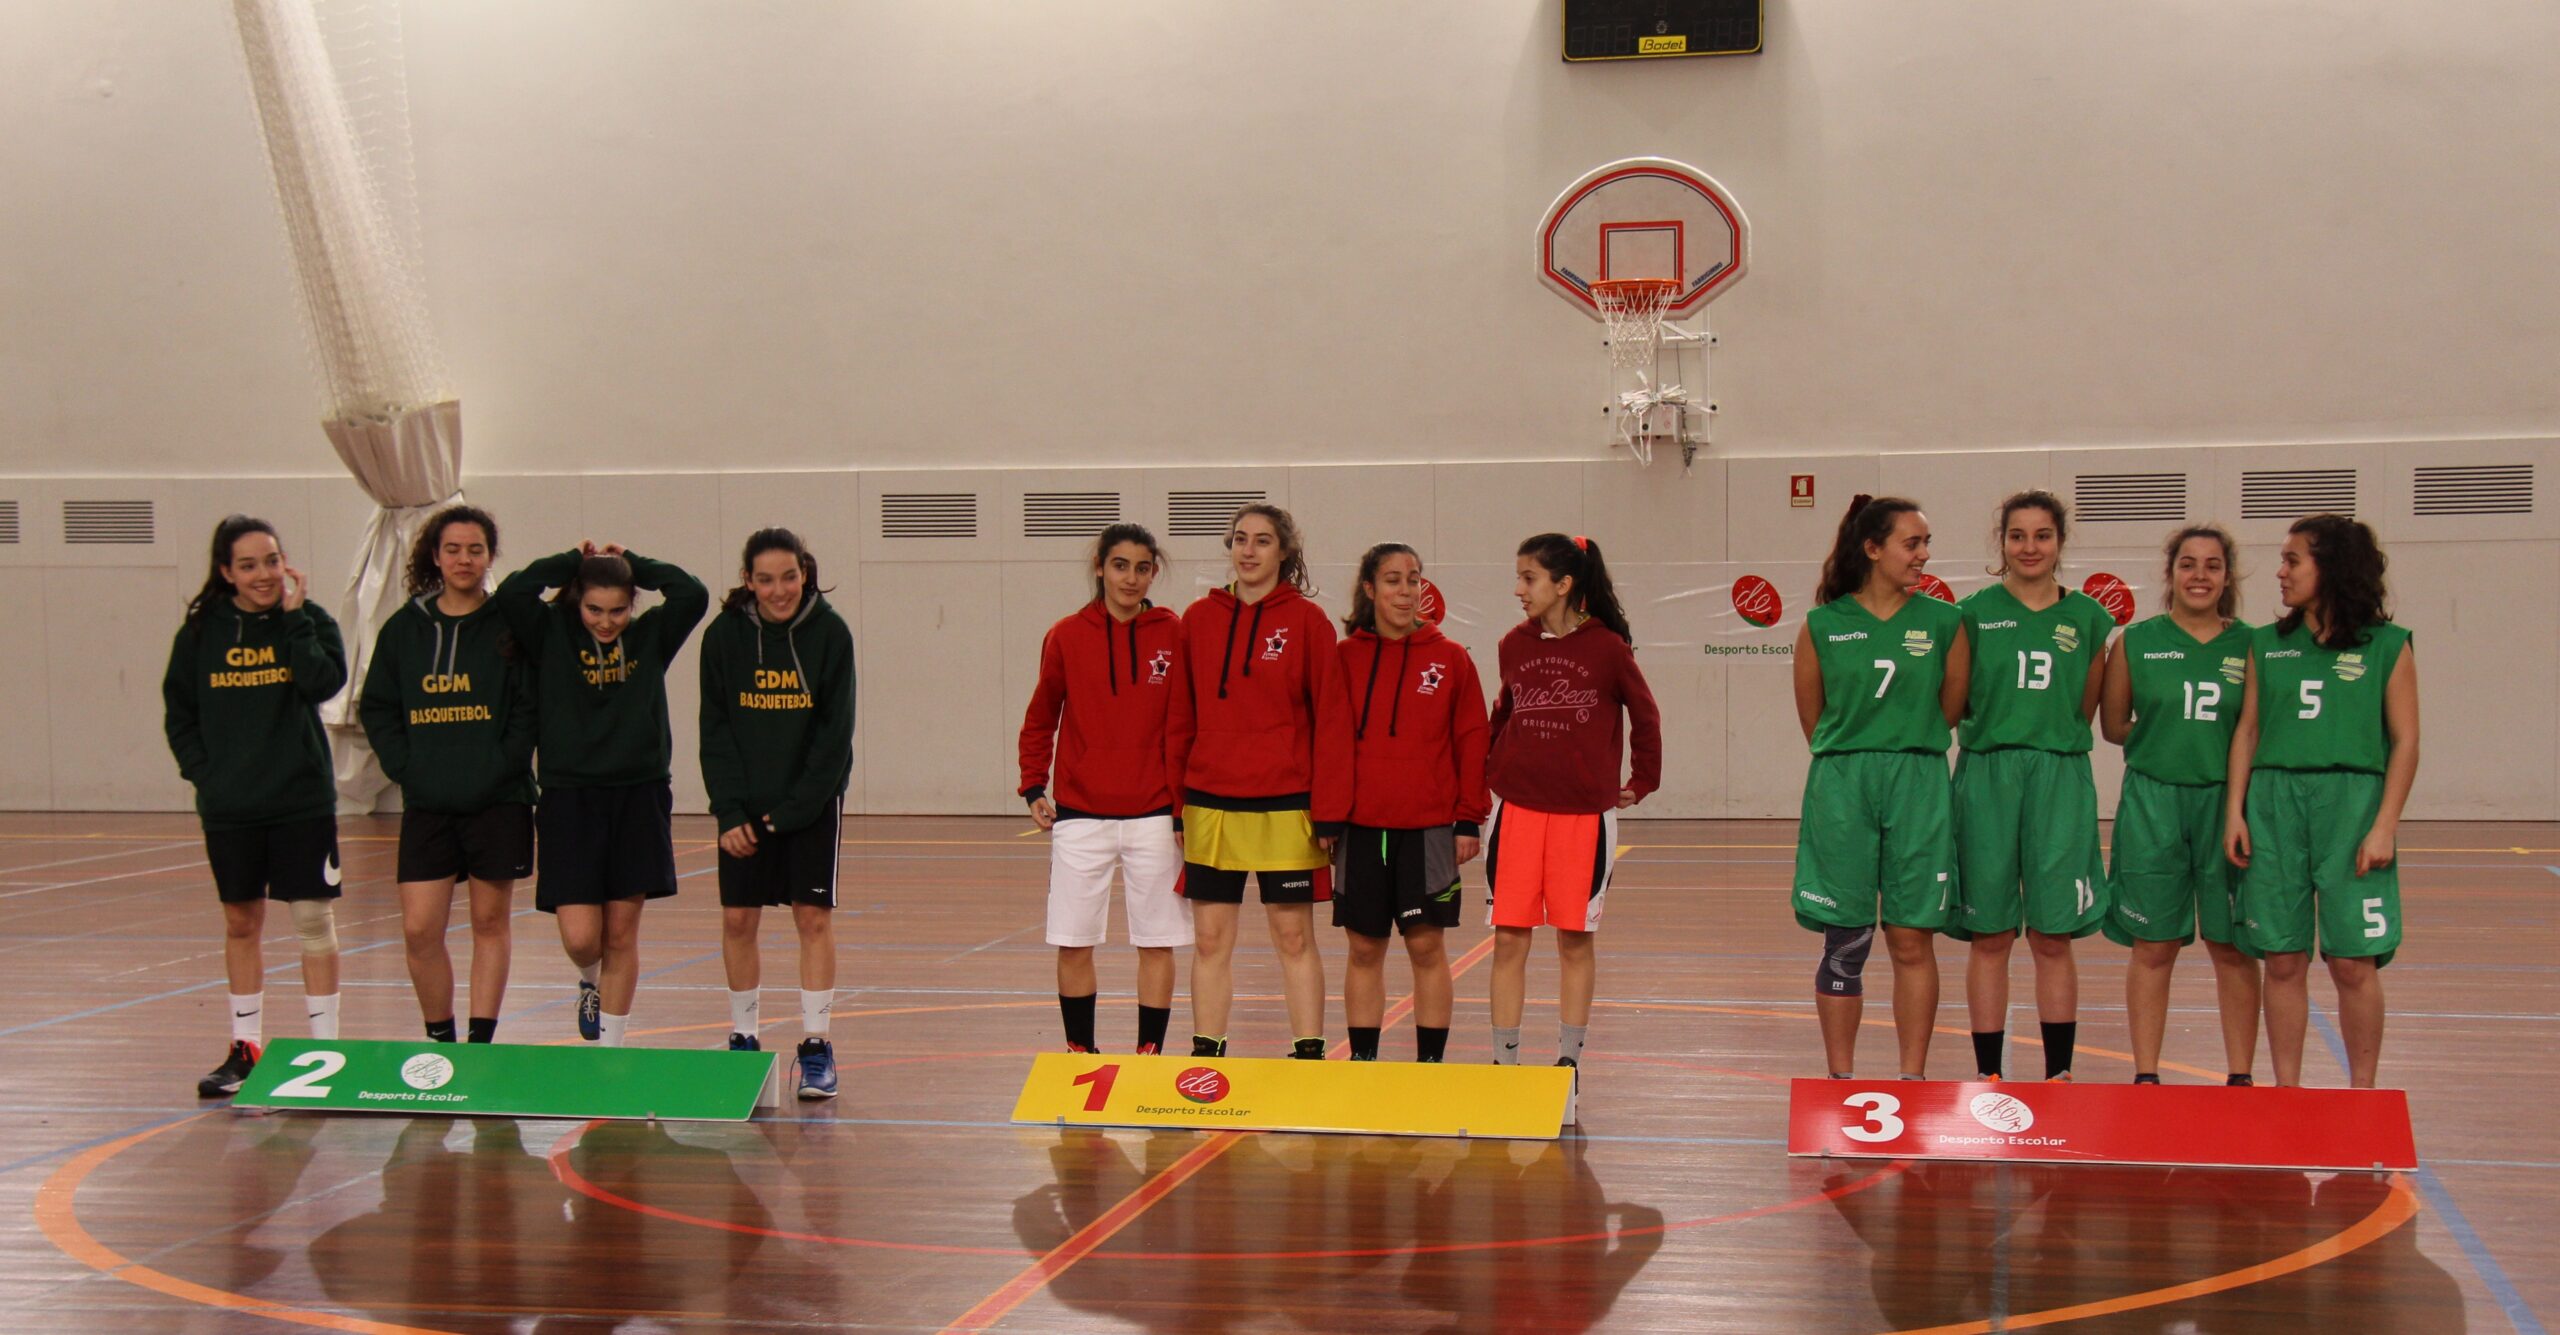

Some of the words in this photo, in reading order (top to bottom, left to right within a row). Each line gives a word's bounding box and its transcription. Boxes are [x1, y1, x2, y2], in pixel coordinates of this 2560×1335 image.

[1642, 38, 1684, 51] Bodet
[1978, 619, 2017, 630] macron
[1828, 631, 1868, 642] macron
[225, 646, 276, 667] GDM
[1704, 644, 1759, 656] Desporto
[1761, 643, 1794, 655] Escol
[2143, 650, 2185, 660] macron
[1545, 656, 1576, 669] YOUNG
[1577, 665, 1589, 677] CO
[2017, 650, 2053, 690] 13
[422, 673, 471, 693] GDM
[754, 669, 800, 689] GDM
[1874, 659, 1896, 699] 7
[740, 692, 814, 709] BASQUETEBOL
[2183, 681, 2221, 721] 12
[2298, 679, 2324, 720] 5
[410, 705, 492, 725] BASQUETEBOL
[1522, 718, 1571, 731] ORIGINAL
[1800, 889, 1837, 909] macron
[2362, 897, 2387, 938] 5
[269, 1050, 347, 1098] 2
[358, 1090, 416, 1101] Desporto
[417, 1092, 468, 1102] Escolar
[1072, 1064, 1121, 1112] 1
[1136, 1105, 1195, 1115] Desporto
[1198, 1107, 1251, 1117] Escolar
[1841, 1091, 1904, 1143] 3
[1939, 1135, 2005, 1146] Desporto
[2008, 1136, 2067, 1146] Escolar
